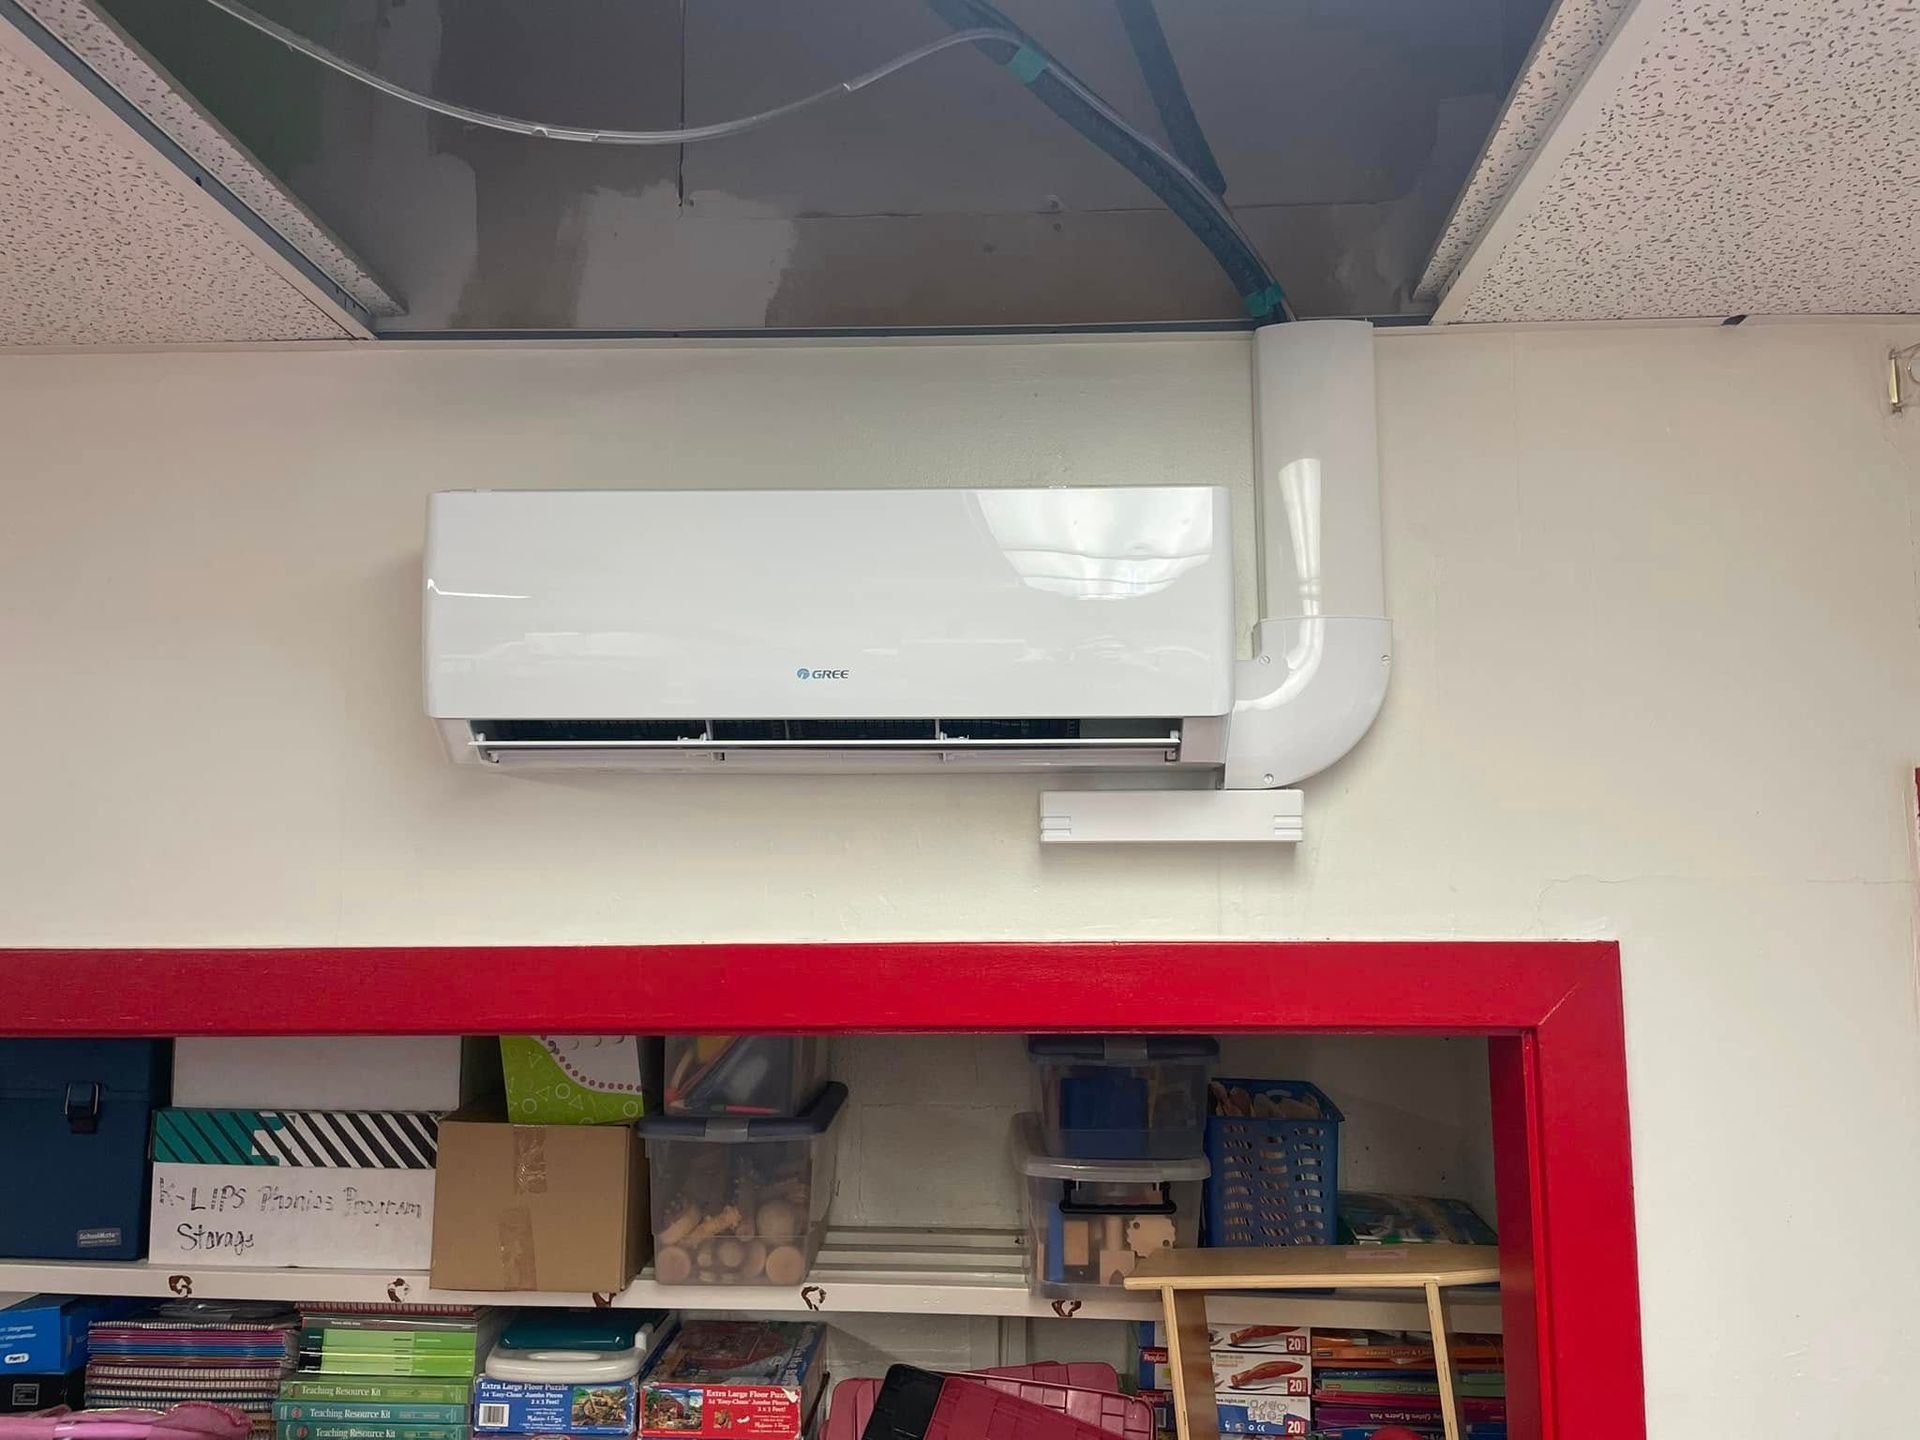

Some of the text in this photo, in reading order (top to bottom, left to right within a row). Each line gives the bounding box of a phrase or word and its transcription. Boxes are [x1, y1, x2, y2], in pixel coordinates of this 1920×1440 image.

[812, 669, 849, 679] GREE
[258, 1185, 334, 1213] Phonics
[342, 1186, 422, 1227] Program
[177, 1223, 254, 1256] Storage
[1288, 1338, 1300, 1351] 20
[302, 1385, 381, 1397] Teaching Resource Kit
[481, 1382, 568, 1391] Extra Large Floor Puzzle
[1289, 1380, 1302, 1393] 20
[727, 1390, 748, 1399] Large
[749, 1390, 769, 1398] Floor
[310, 1408, 391, 1419] Teaching Resource Kit
[316, 1428, 396, 1439] Teaching Resource Kit
[1287, 1421, 1300, 1434] 20
